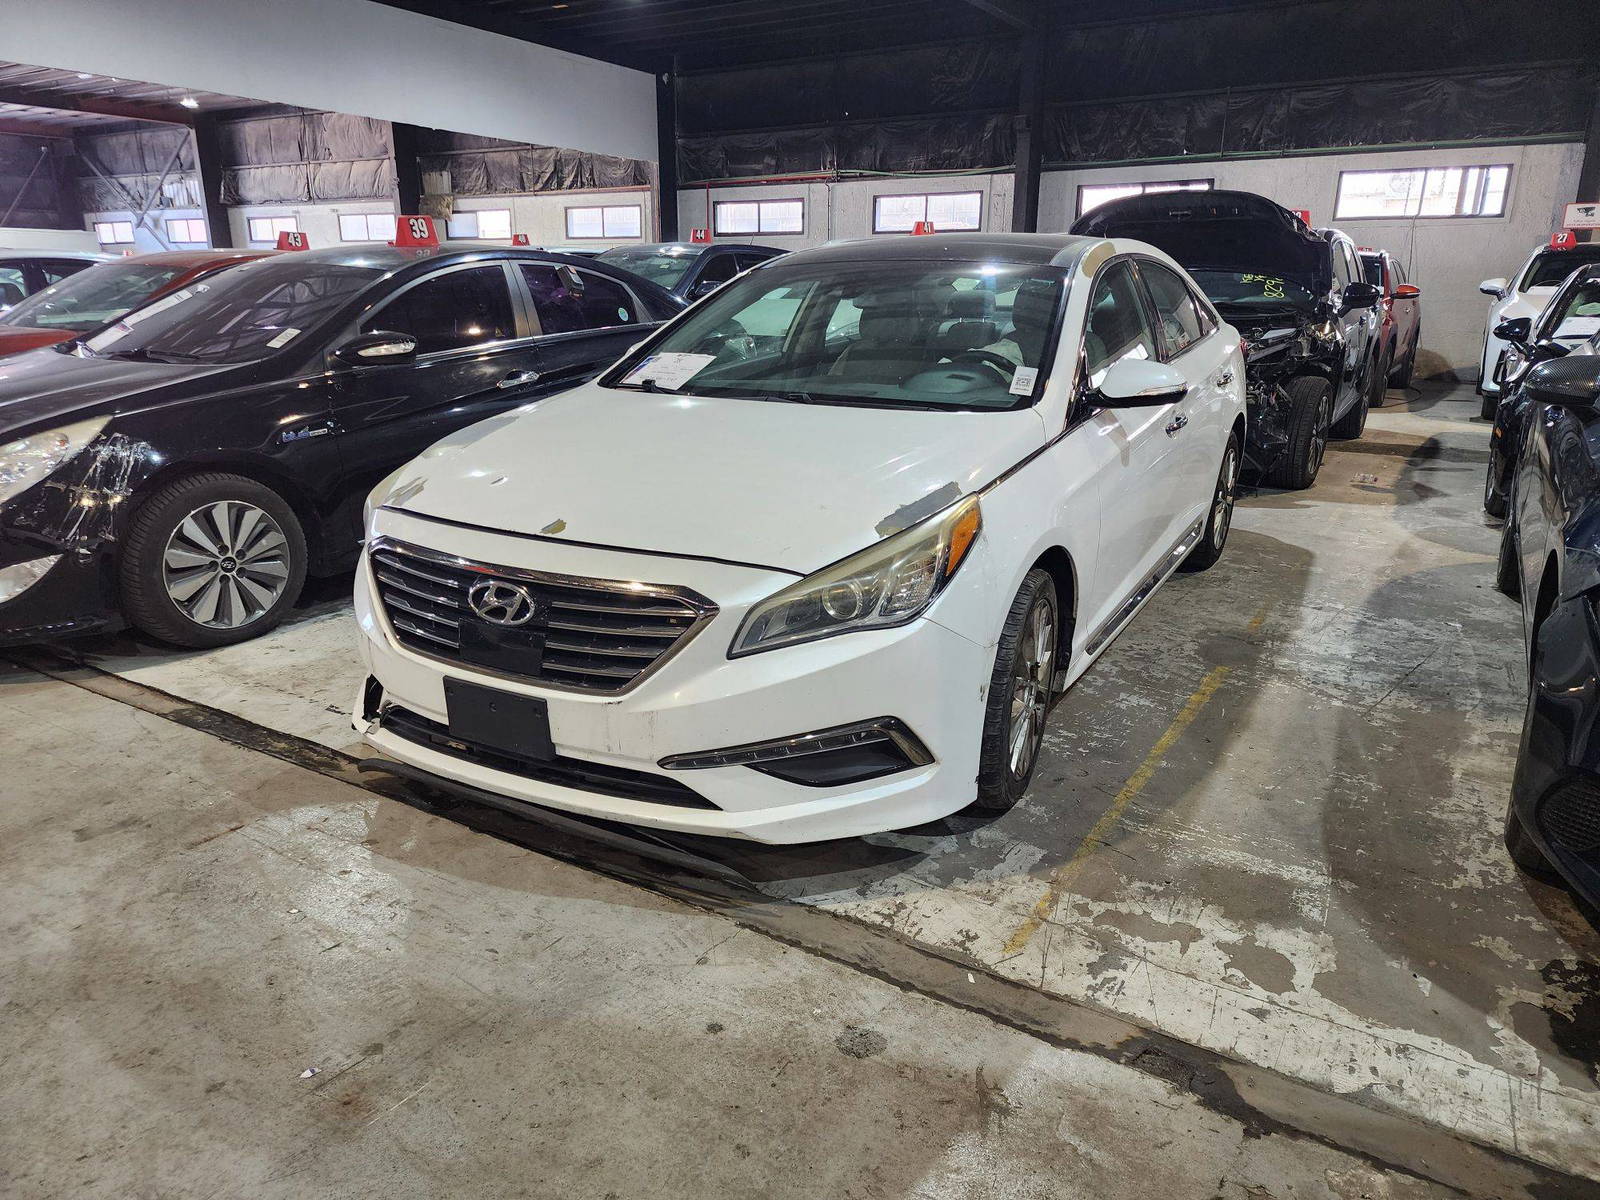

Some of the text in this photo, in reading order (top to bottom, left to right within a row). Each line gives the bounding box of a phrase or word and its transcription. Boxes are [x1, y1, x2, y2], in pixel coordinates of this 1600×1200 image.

[409, 218, 429, 239] 39
[288, 232, 302, 247] 43
[1557, 233, 1568, 244] 27
